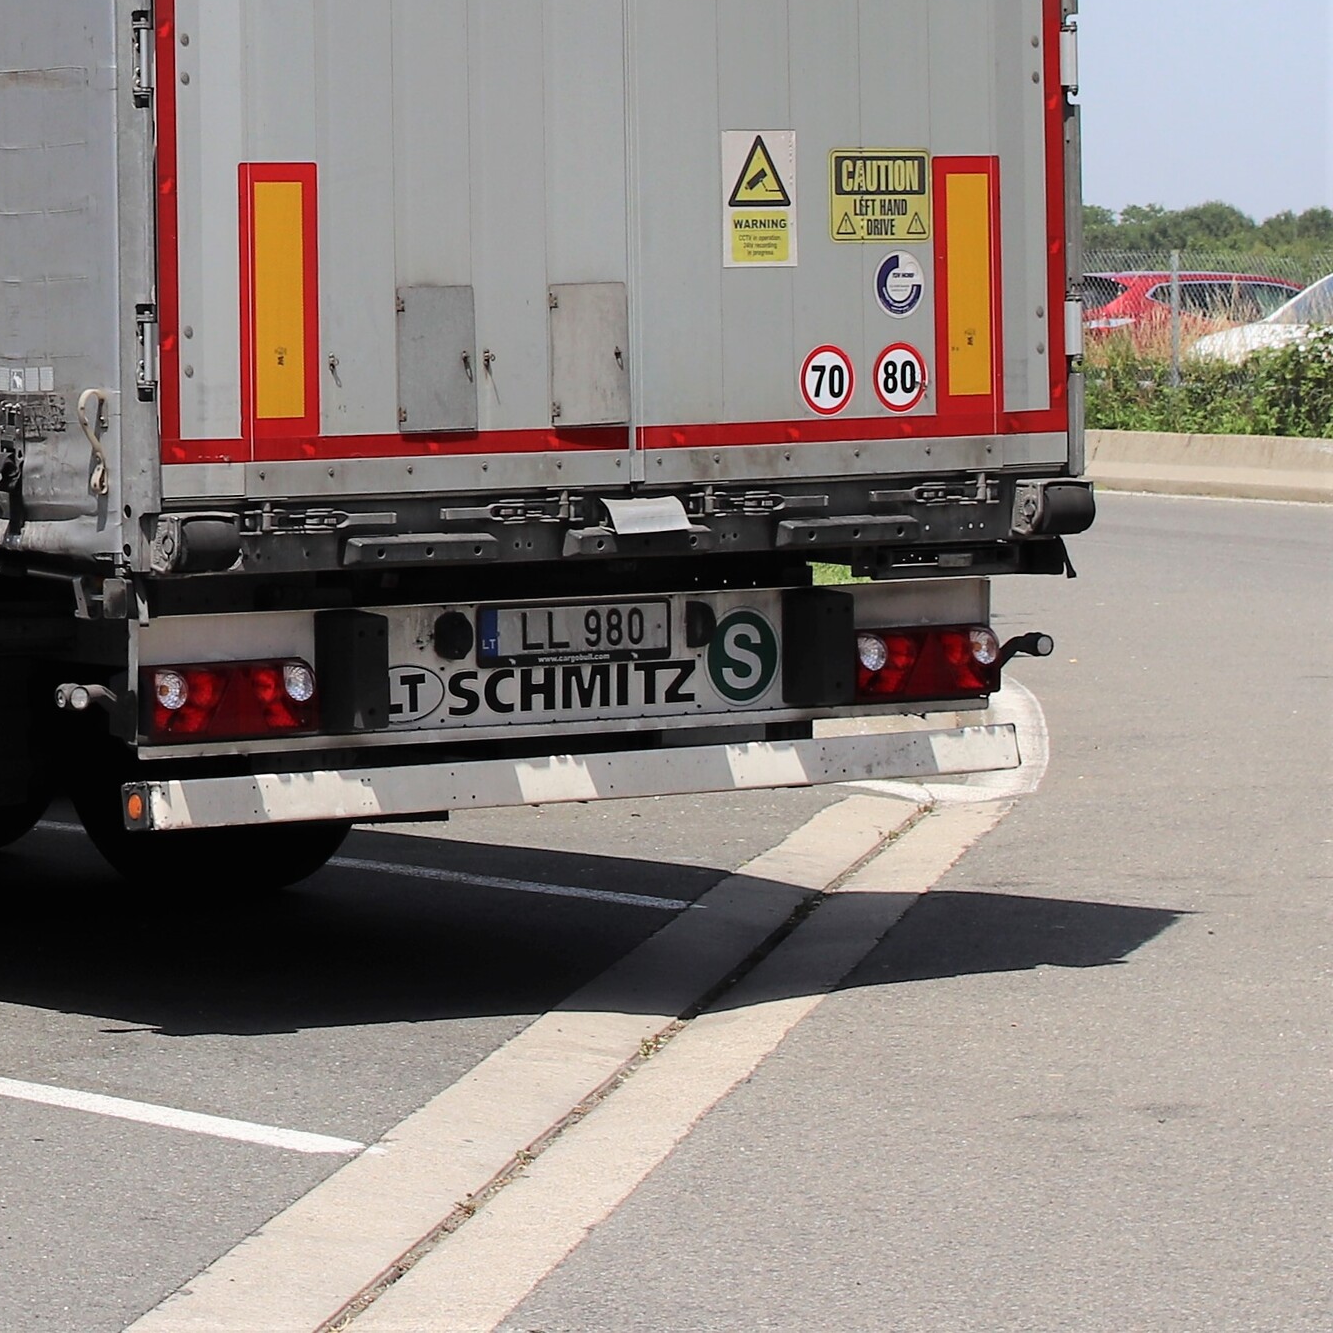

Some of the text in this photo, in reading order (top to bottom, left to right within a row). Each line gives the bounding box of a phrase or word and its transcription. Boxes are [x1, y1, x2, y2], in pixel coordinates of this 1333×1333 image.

[841, 159, 919, 192] CAUTION
[853, 198, 907, 216] LEFT HAND
[733, 219, 787, 229] WARNING
[866, 218, 895, 236] DRIVE
[811, 364, 844, 399] 70
[882, 360, 917, 394] 80
[482, 606, 644, 651] LT LL 980
[537, 652, 610, 664] www.cargobull.com
[721, 622, 763, 690] S
[448, 659, 696, 716] SCHMITZ
